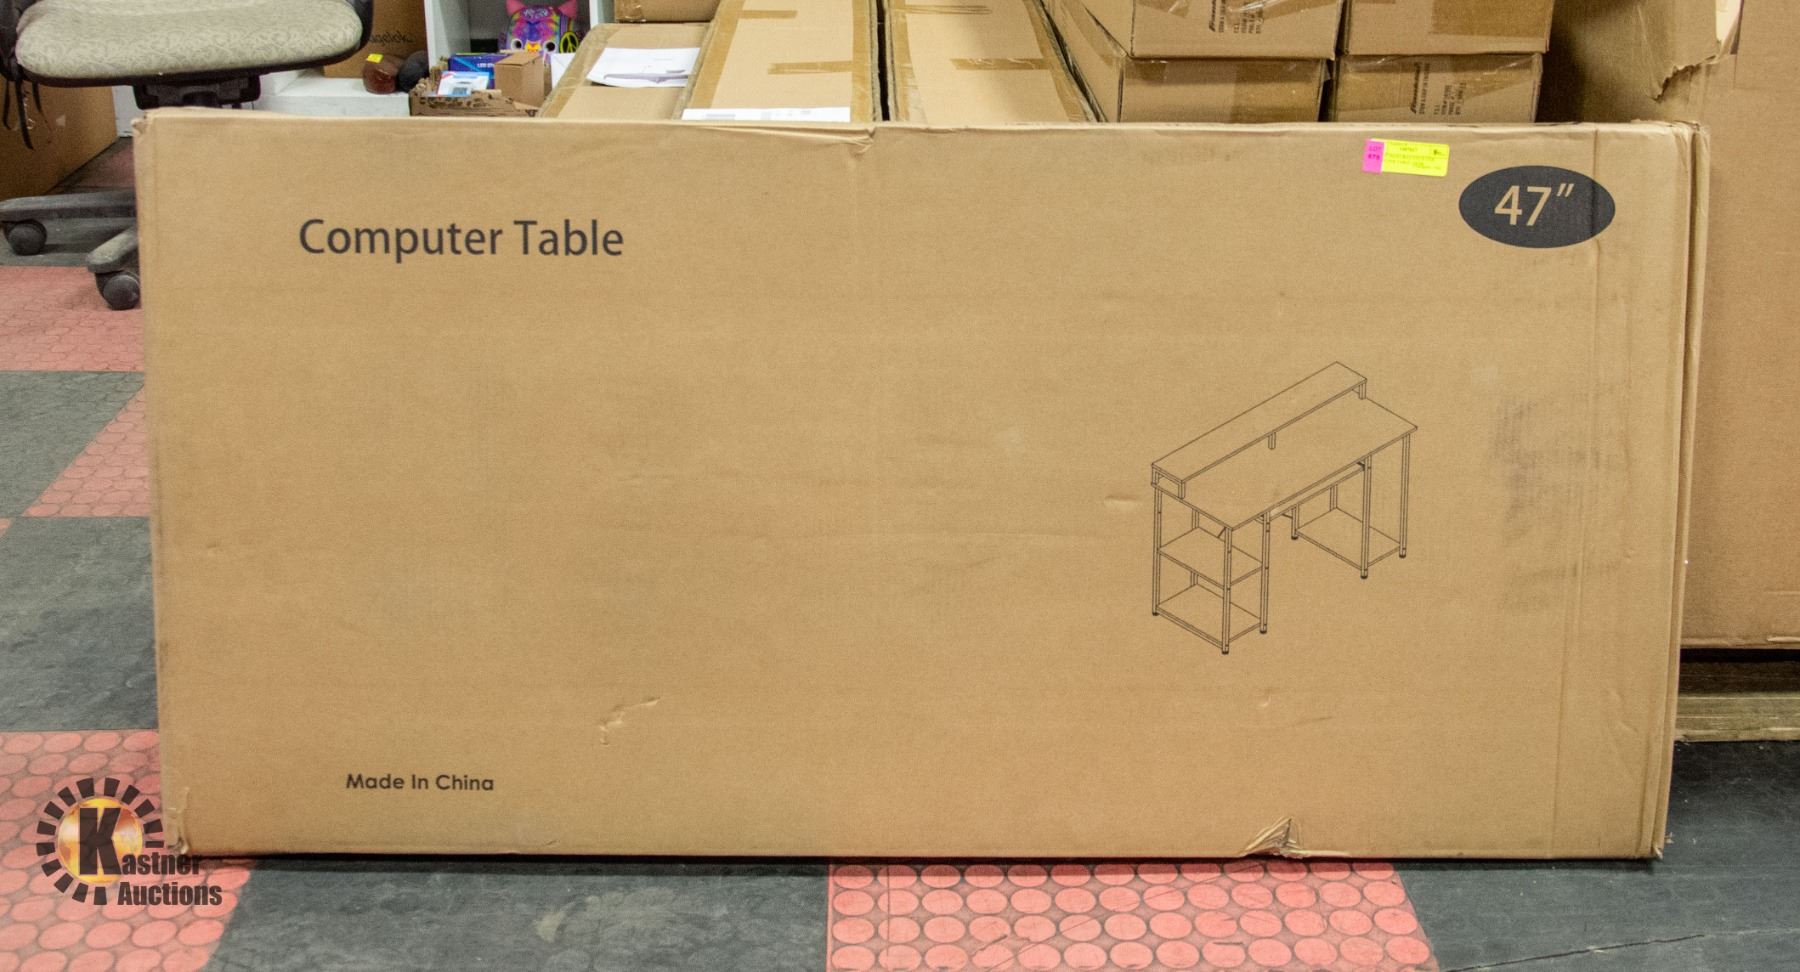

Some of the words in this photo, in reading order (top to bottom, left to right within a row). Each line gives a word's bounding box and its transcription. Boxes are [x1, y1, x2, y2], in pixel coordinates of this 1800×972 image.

[1494, 183, 1575, 226] 47"
[299, 218, 503, 263] Computer
[514, 219, 624, 256] Table
[346, 773, 404, 790] Made
[411, 774, 428, 790] In
[435, 774, 494, 791] China
